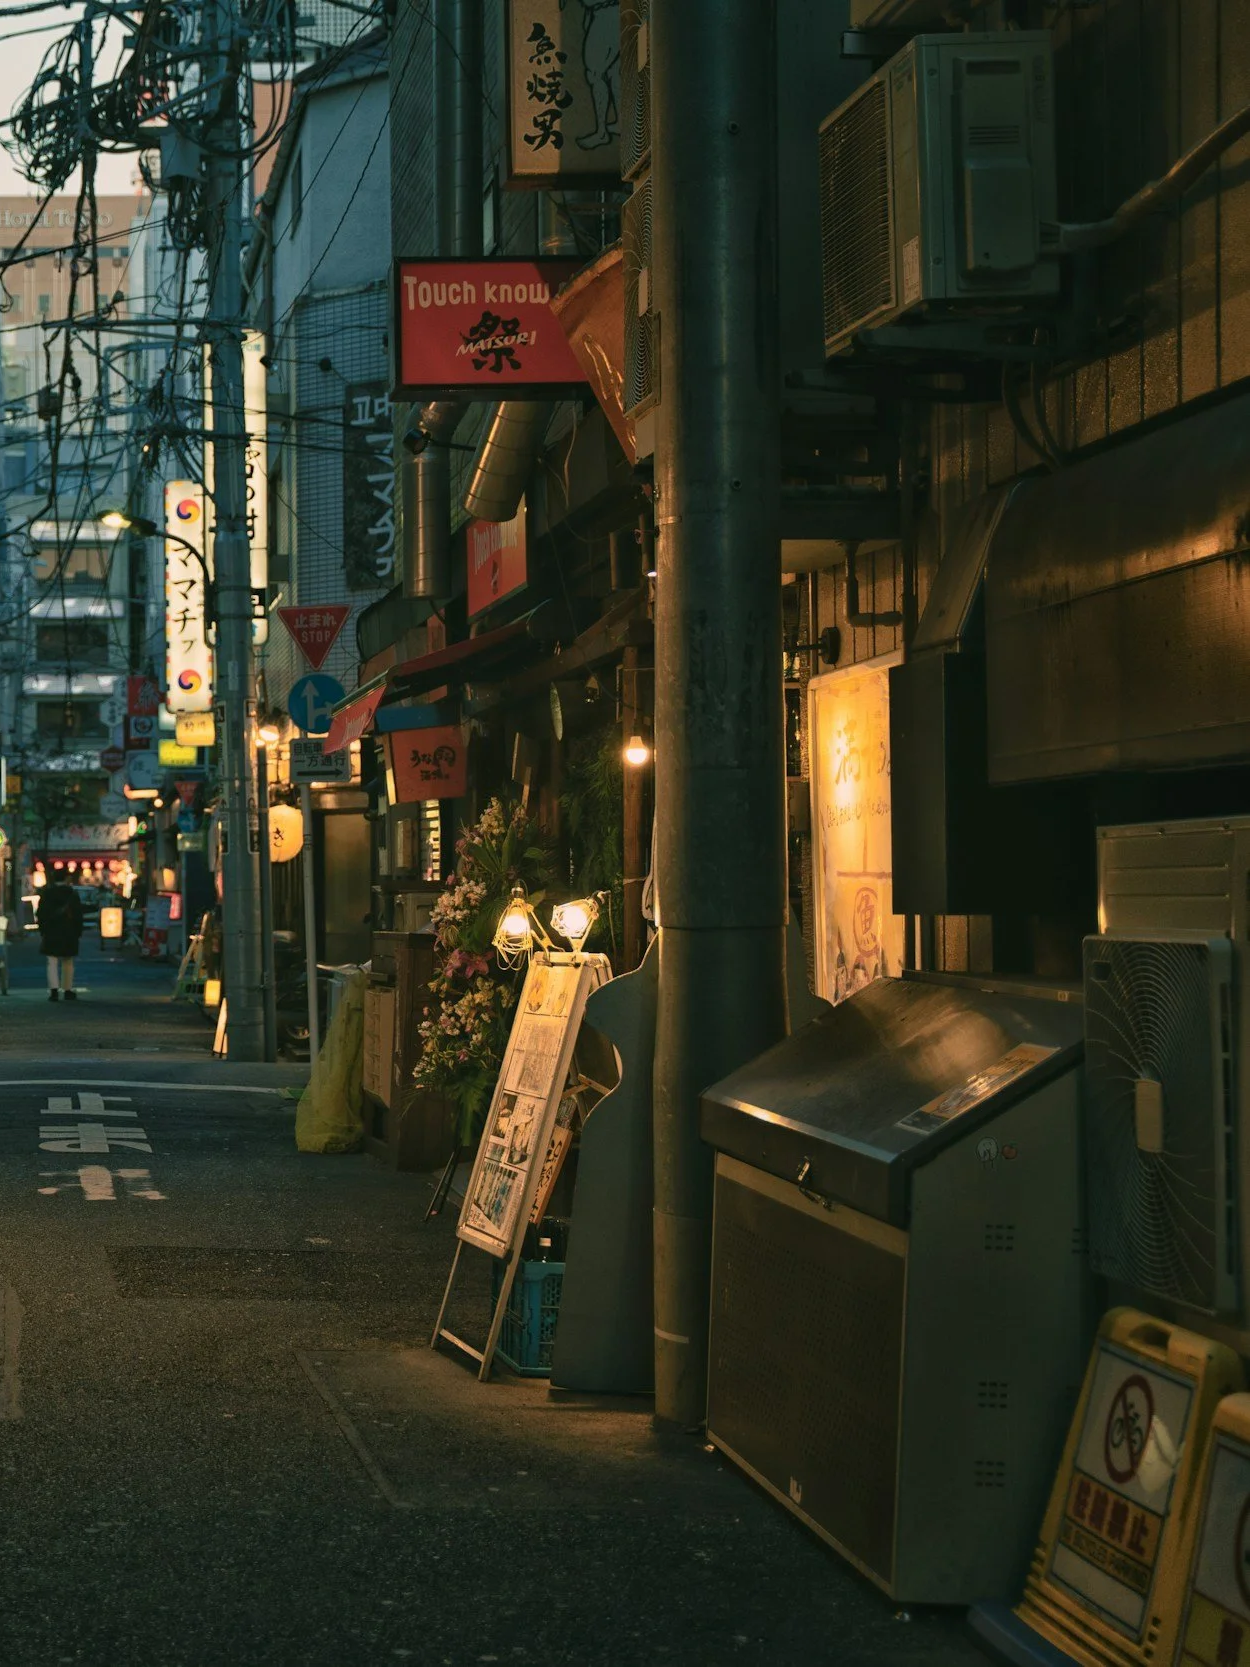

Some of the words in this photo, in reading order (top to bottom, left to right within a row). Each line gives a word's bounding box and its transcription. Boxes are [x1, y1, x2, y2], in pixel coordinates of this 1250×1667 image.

[403, 276, 476, 310] Touch
[484, 280, 549, 305] know
[455, 331, 537, 356] MATSURI
[294, 612, 337, 629] 止まれ
[301, 630, 331, 643] STOP
[294, 755, 346, 768] 一方通行
